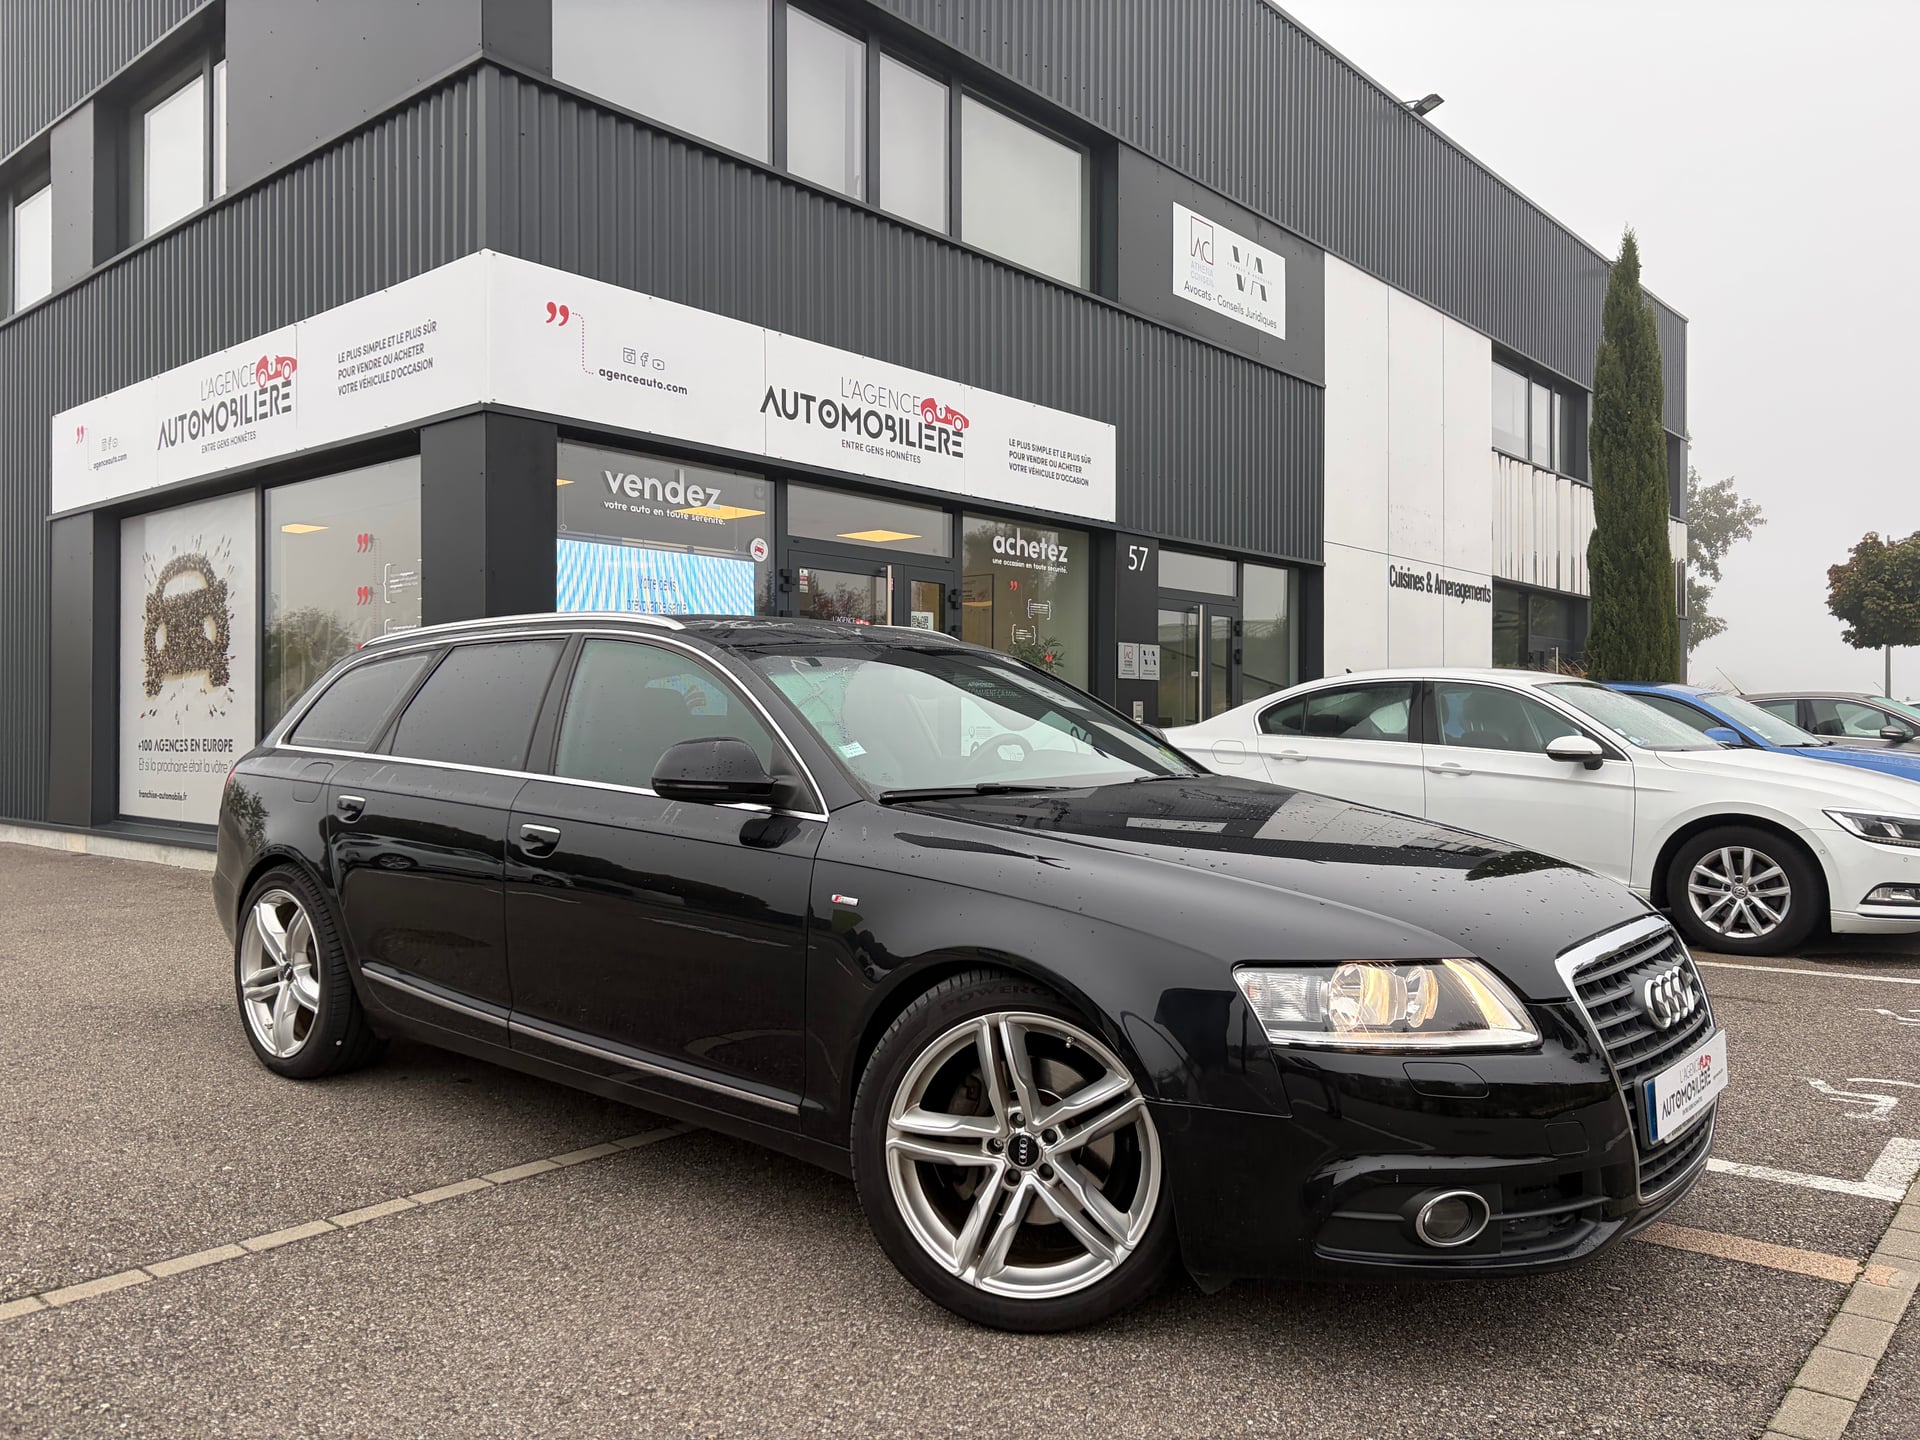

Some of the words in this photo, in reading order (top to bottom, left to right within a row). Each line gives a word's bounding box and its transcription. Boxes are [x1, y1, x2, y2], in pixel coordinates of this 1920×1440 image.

[1184, 280, 1212, 301] Avocats
[1217, 294, 1244, 315] Conseils
[1245, 307, 1277, 329] Juridiques
[338, 351, 345, 363] LE
[346, 346, 362, 361] PLUS
[363, 338, 386, 355] SIMPLE
[387, 334, 396, 347] ET
[396, 332, 404, 344] LE
[405, 326, 422, 341] PLUS
[423, 319, 437, 335] SÛR
[338, 365, 356, 380] POUR
[356, 357, 382, 373] VENDRE
[382, 354, 393, 367] OU
[394, 342, 425, 361] ACHETER
[200, 362, 256, 401] L'AGENCE
[338, 380, 358, 396] VOTRE
[359, 370, 390, 390] VÉHICULE
[391, 357, 434, 381] D'OCCASION
[599, 367, 688, 395] agenceauto.com
[841, 376, 921, 416] L'AGENCE
[201, 441, 216, 453] ENTRE
[216, 437, 230, 450] GENS
[230, 430, 257, 446] HONNÊTES
[841, 439, 864, 452] ENTRE
[865, 444, 885, 456] GENS
[1009, 438, 1015, 447] LE
[1017, 440, 1031, 451] PLUS
[1032, 443, 1052, 456] SIMPLE
[1053, 448, 1059, 457] ET
[1060, 450, 1066, 459] LE
[1067, 452, 1080, 463] PLUS
[1081, 454, 1092, 464] SÛR
[1009, 450, 1025, 461] POUR
[1026, 454, 1048, 466] VENDRE
[1049, 460, 1058, 468] OU
[1058, 462, 1082, 474] ACHETER
[1009, 462, 1027, 473] VOTRE
[1028, 465, 1055, 480] VÉHICULE
[1056, 473, 1089, 486] D'OCCASION
[604, 469, 721, 510] vendez
[604, 501, 628, 511] votre
[630, 504, 651, 514] auto
[653, 508, 664, 516] en
[666, 508, 688, 520] toute
[993, 528, 1068, 562] achetez
[1128, 545, 1149, 571] 57
[1003, 560, 1025, 568] occasion
[1033, 562, 1046, 571] toute
[1390, 564, 1425, 592] Cuisines
[1426, 571, 1433, 593] &
[1434, 573, 1491, 604] Amenagements
[138, 739, 153, 752] +100
[154, 739, 188, 752] AGENCES
[190, 739, 200, 752] EN
[202, 739, 233, 753] EUROPE
[138, 757, 144, 771] Et
[150, 757, 156, 771] la
[157, 758, 188, 775] prochaine
[189, 758, 202, 773] était
[204, 758, 210, 773] la
